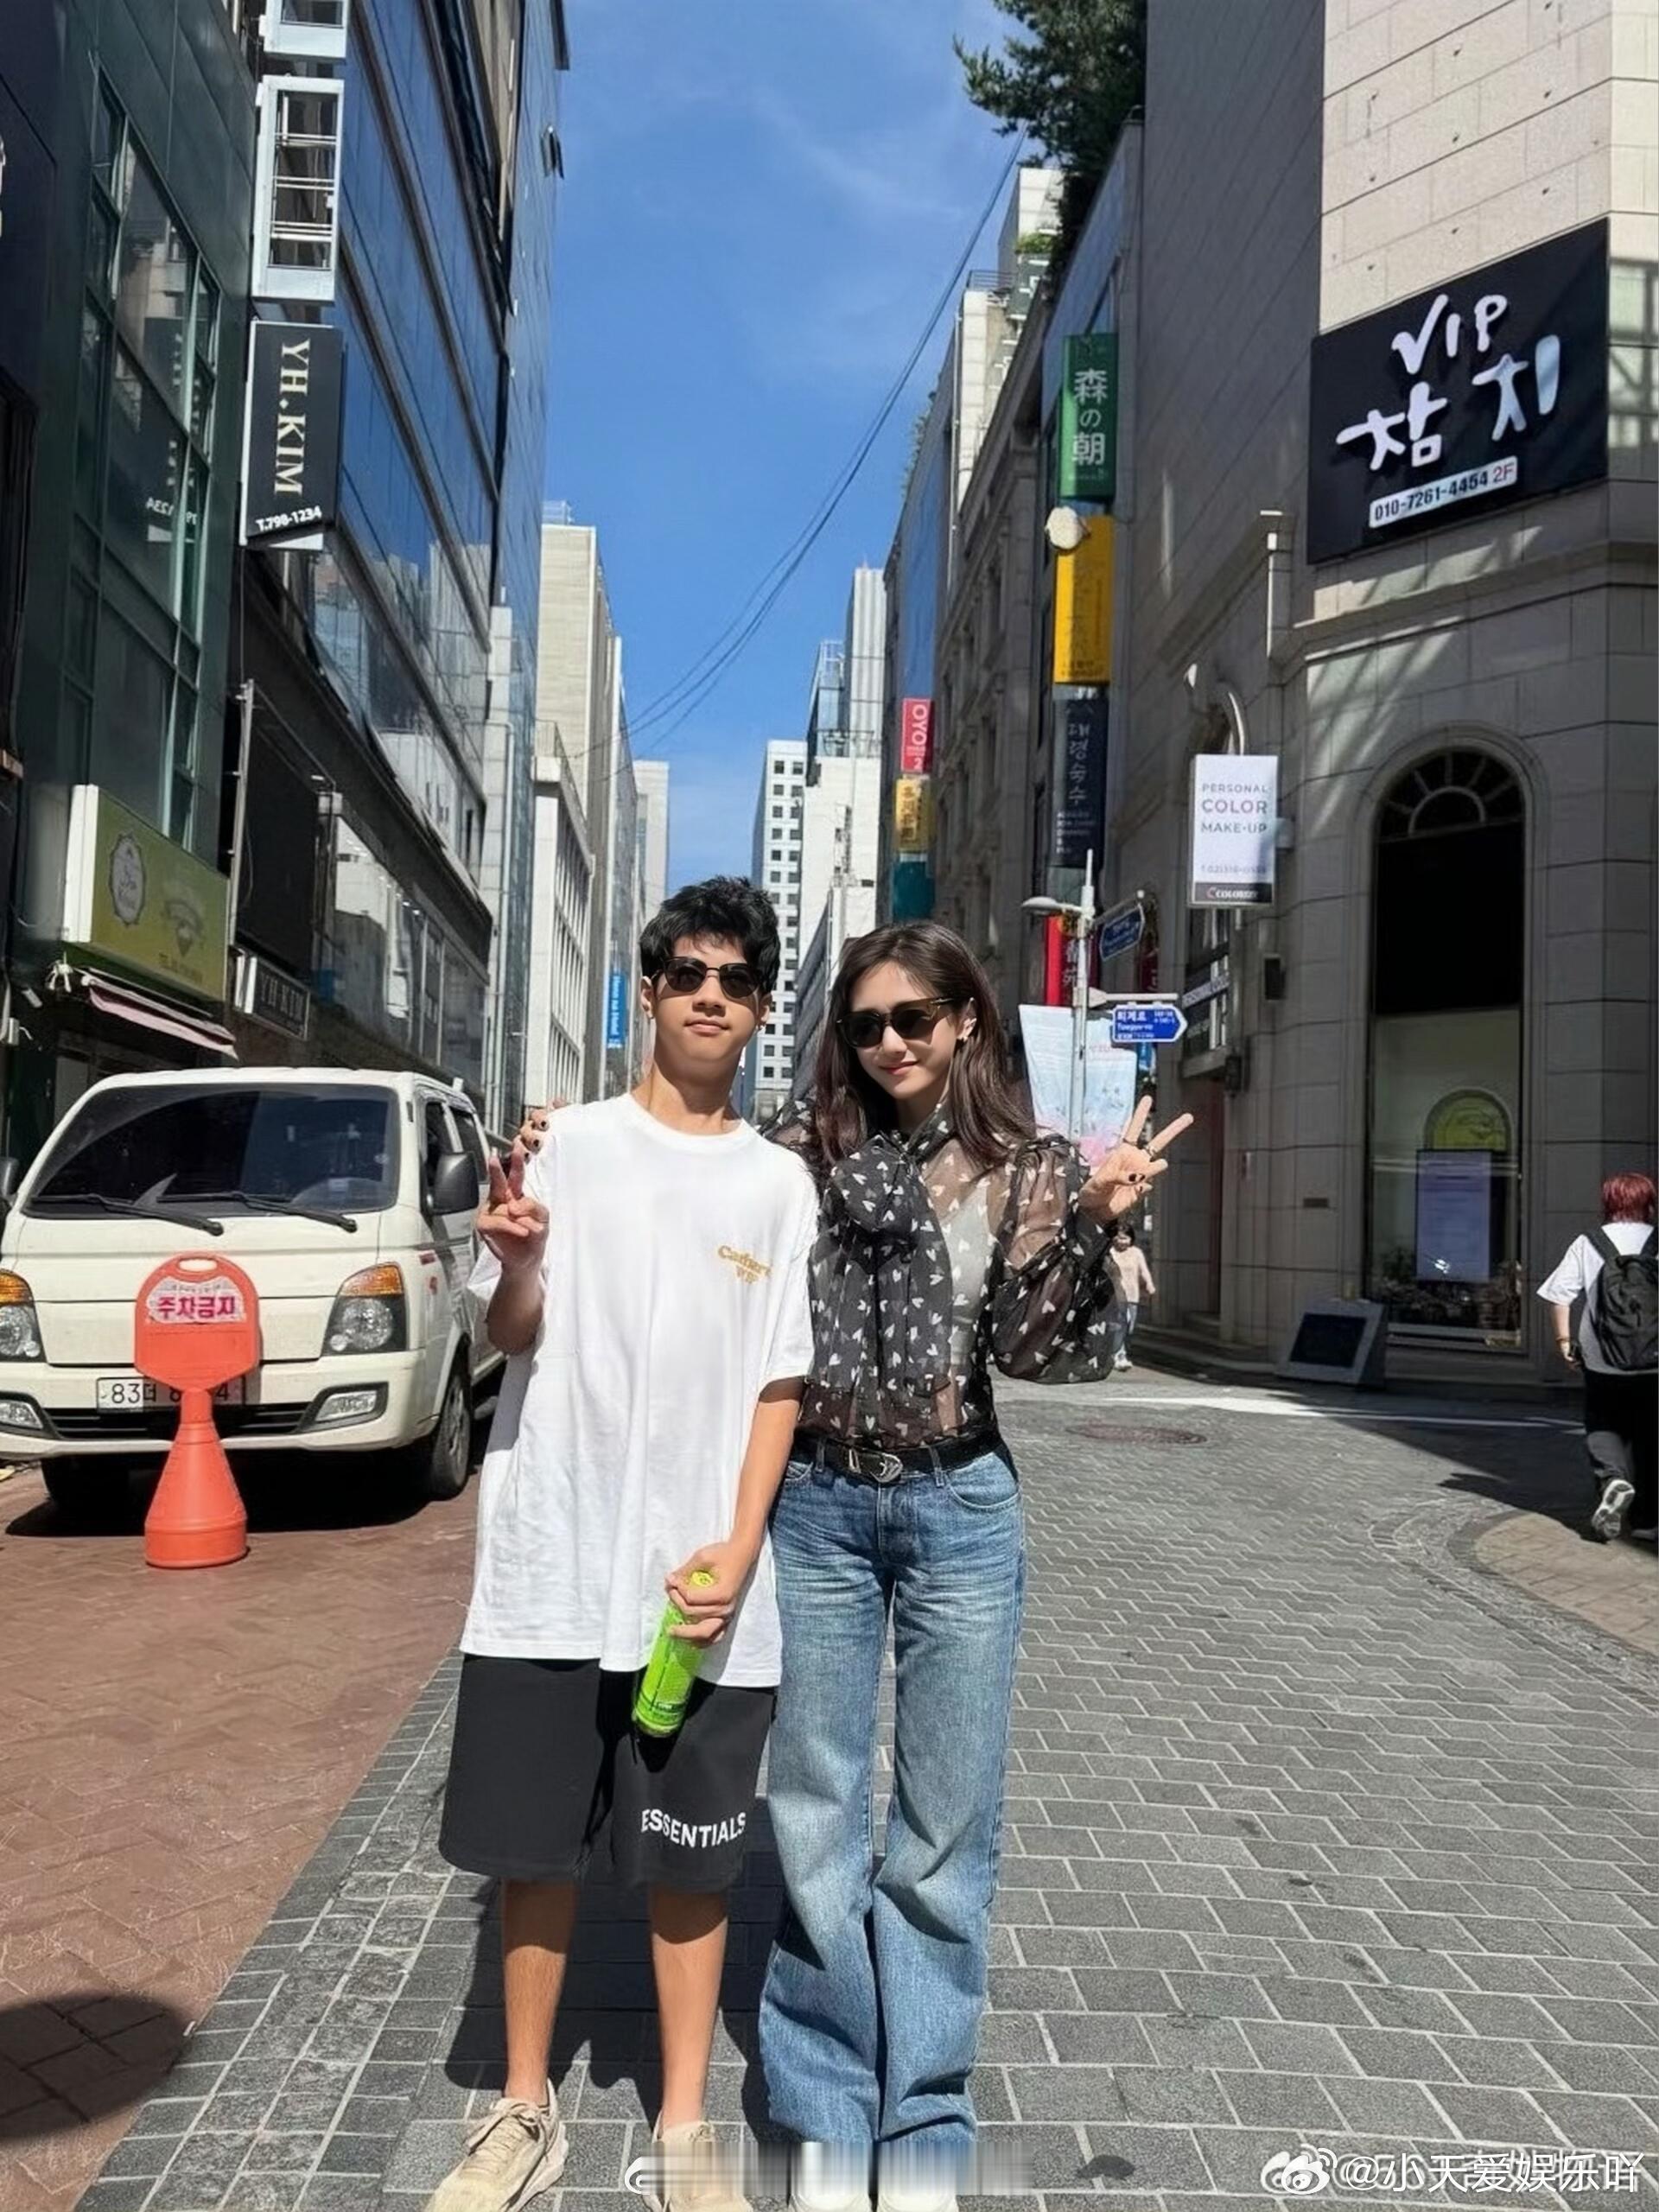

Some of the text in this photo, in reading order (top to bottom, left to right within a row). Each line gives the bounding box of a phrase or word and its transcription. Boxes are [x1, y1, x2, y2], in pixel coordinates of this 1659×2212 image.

[1391, 294, 1507, 374] VIP
[1071, 368, 1108, 465] 森の朝
[1375, 461, 1515, 520] 010-7261-4454 2F
[912, 704, 927, 746] OYO
[1202, 784, 1268, 793] PERSONAL
[1202, 799, 1268, 814] COLOR
[158, 1296, 236, 1319] 주차금지
[641, 1808, 747, 1848] ESSENTIALS
